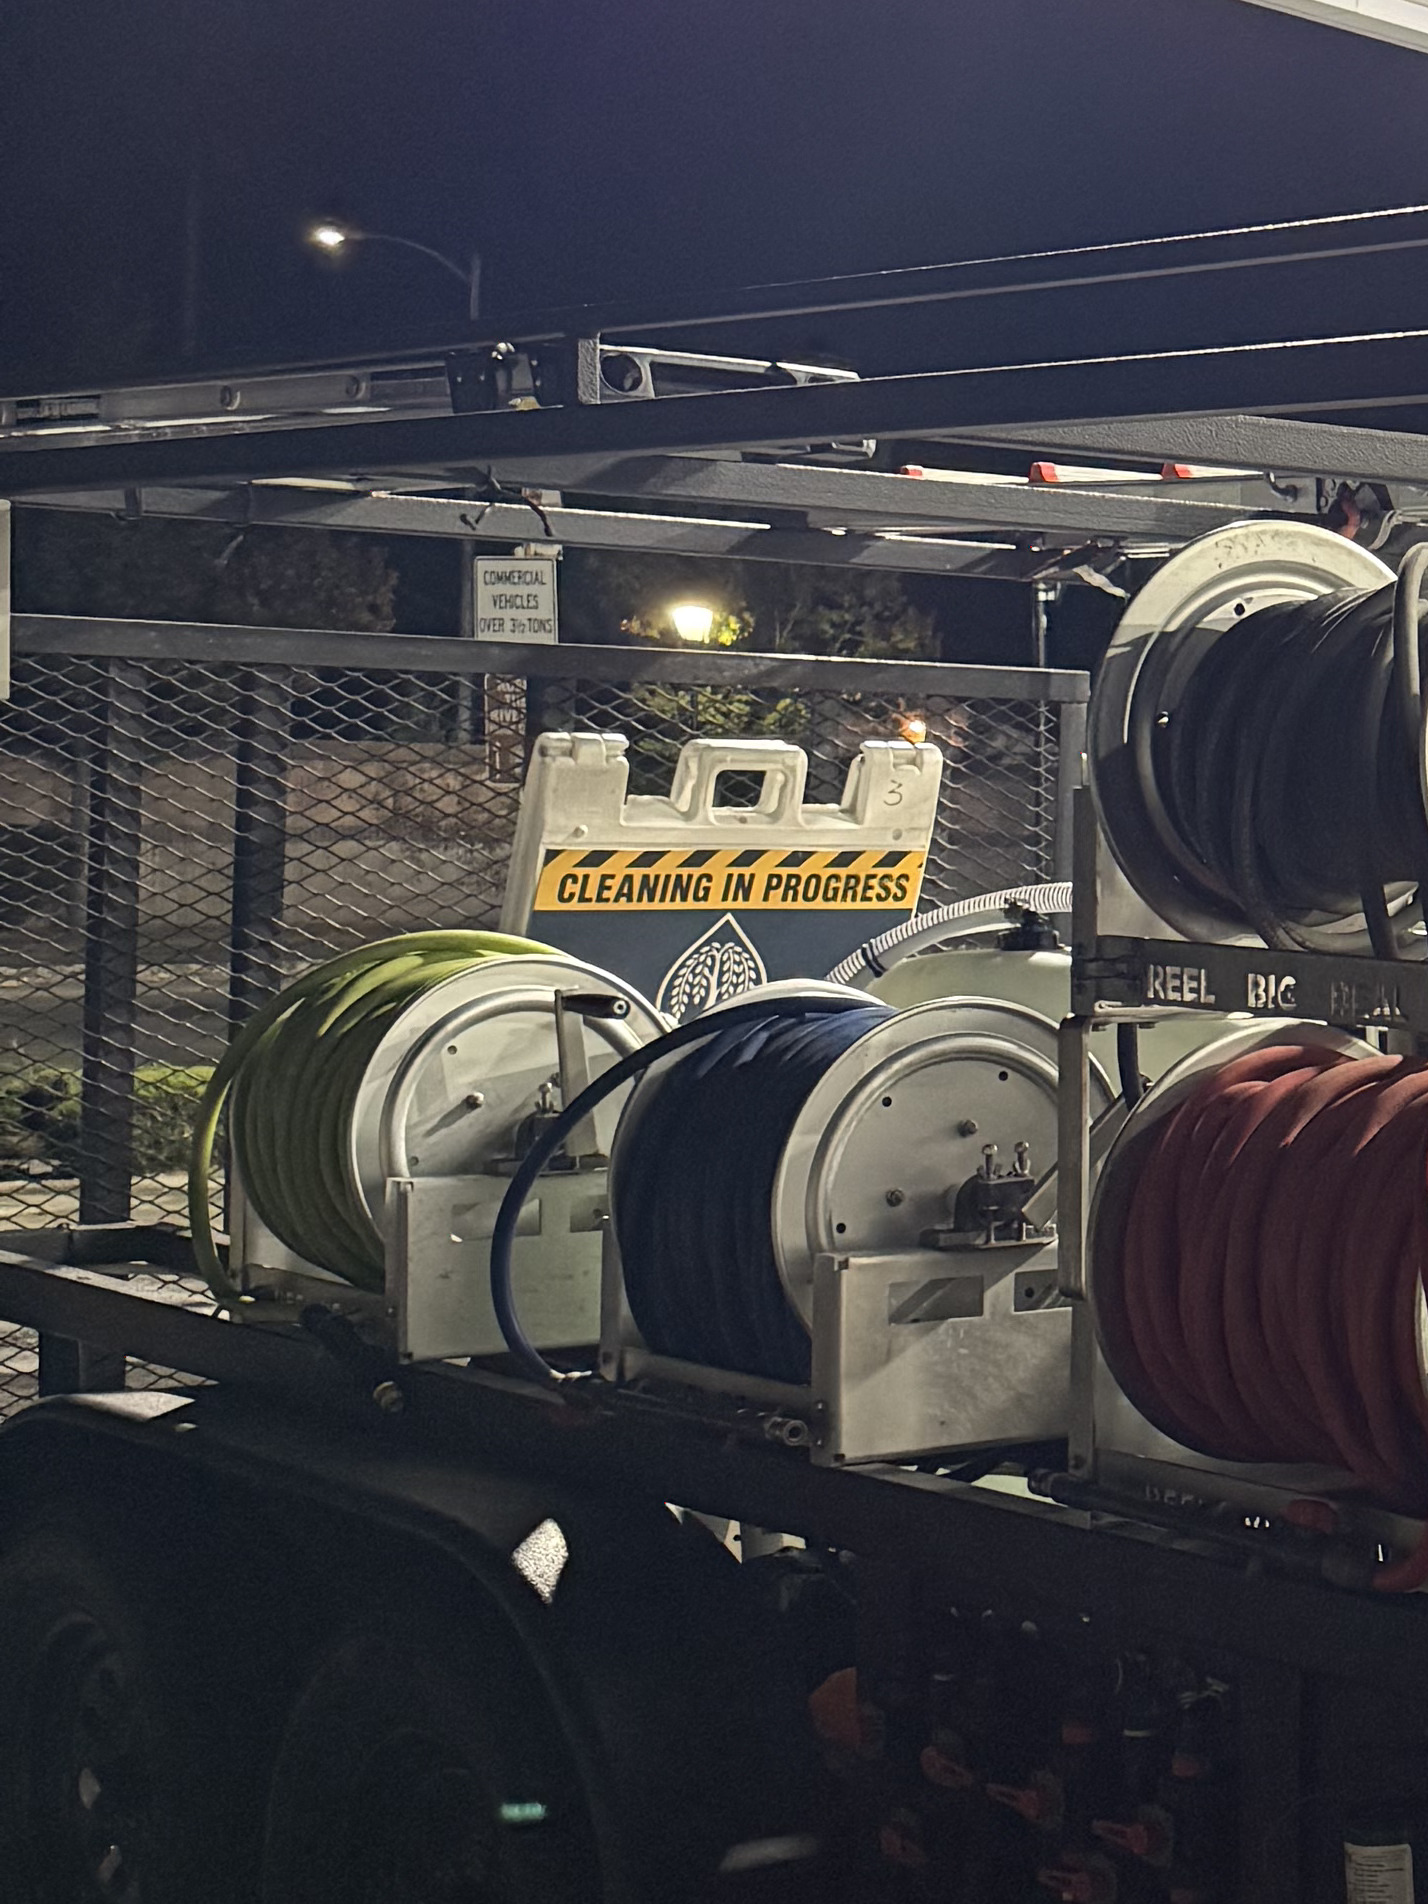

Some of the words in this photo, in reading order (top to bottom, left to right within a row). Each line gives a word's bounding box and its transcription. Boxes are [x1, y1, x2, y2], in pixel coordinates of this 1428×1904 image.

[483, 570, 548, 587] COMMERCIAL
[492, 594, 539, 611] VEHICLES
[479, 617, 505, 634] OVER
[527, 618, 554, 635] TONS
[883, 779, 904, 807] 3
[558, 873, 714, 904] CLEANING
[722, 872, 756, 903] IN
[762, 872, 911, 903] PROGRESS
[1147, 963, 1216, 1005] REEL
[1247, 972, 1298, 1012] BIG
